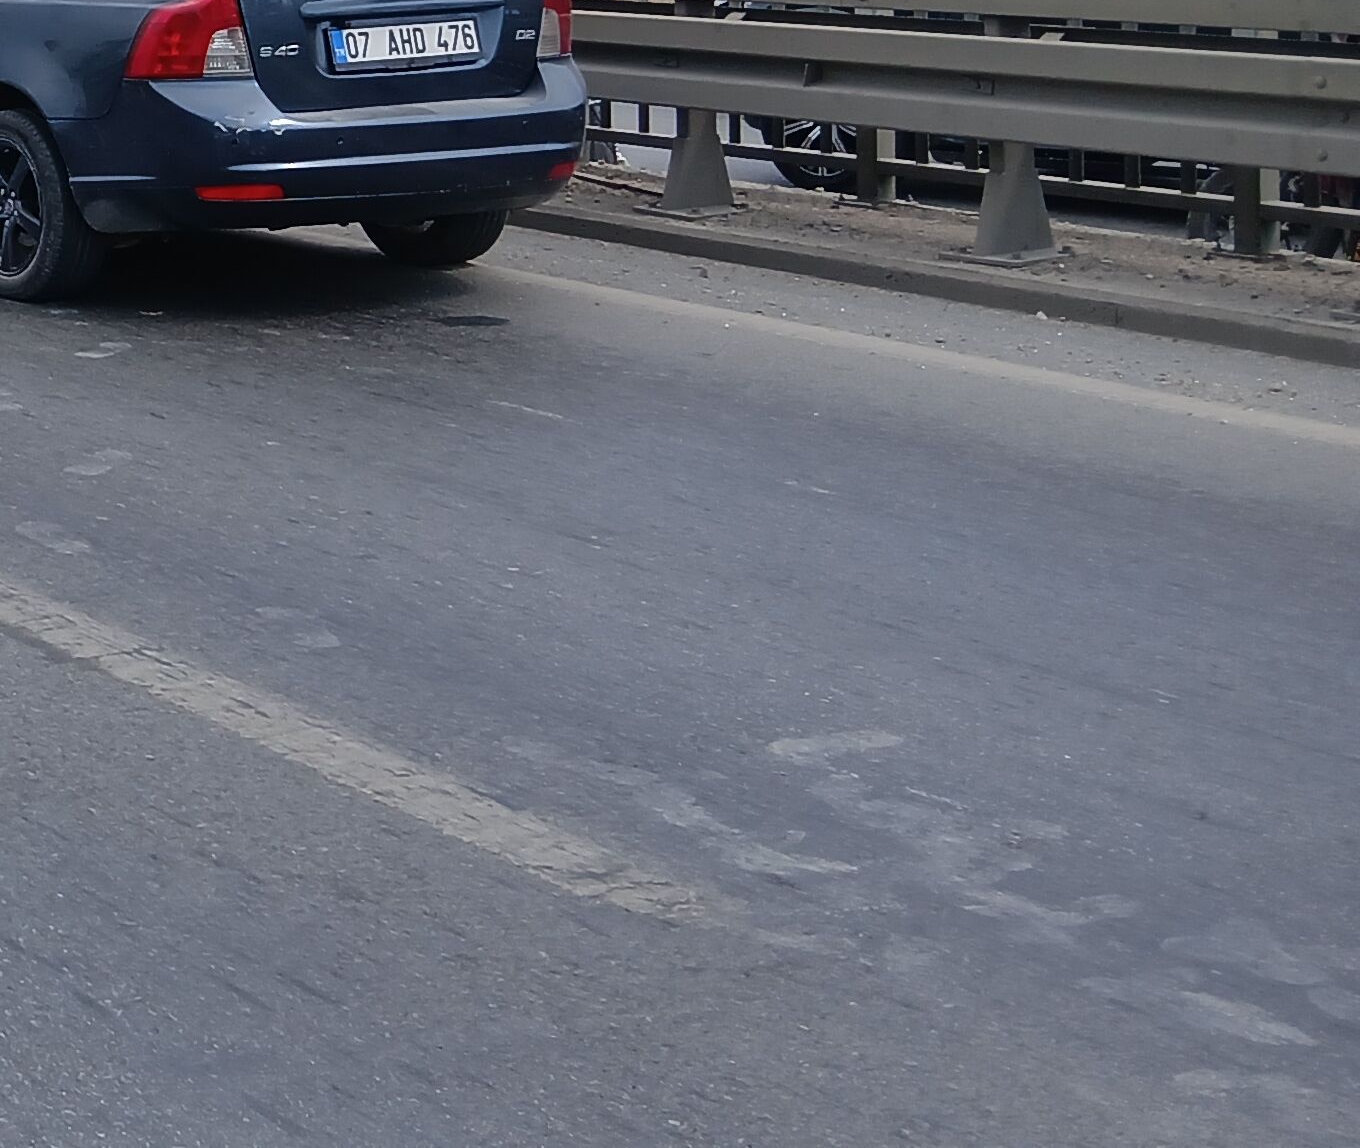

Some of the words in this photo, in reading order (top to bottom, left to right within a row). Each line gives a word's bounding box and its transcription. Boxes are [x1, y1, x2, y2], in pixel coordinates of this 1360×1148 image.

[258, 43, 300, 58] S40
[344, 31, 370, 59] 07
[387, 28, 428, 56] AHD
[436, 23, 476, 53] 476
